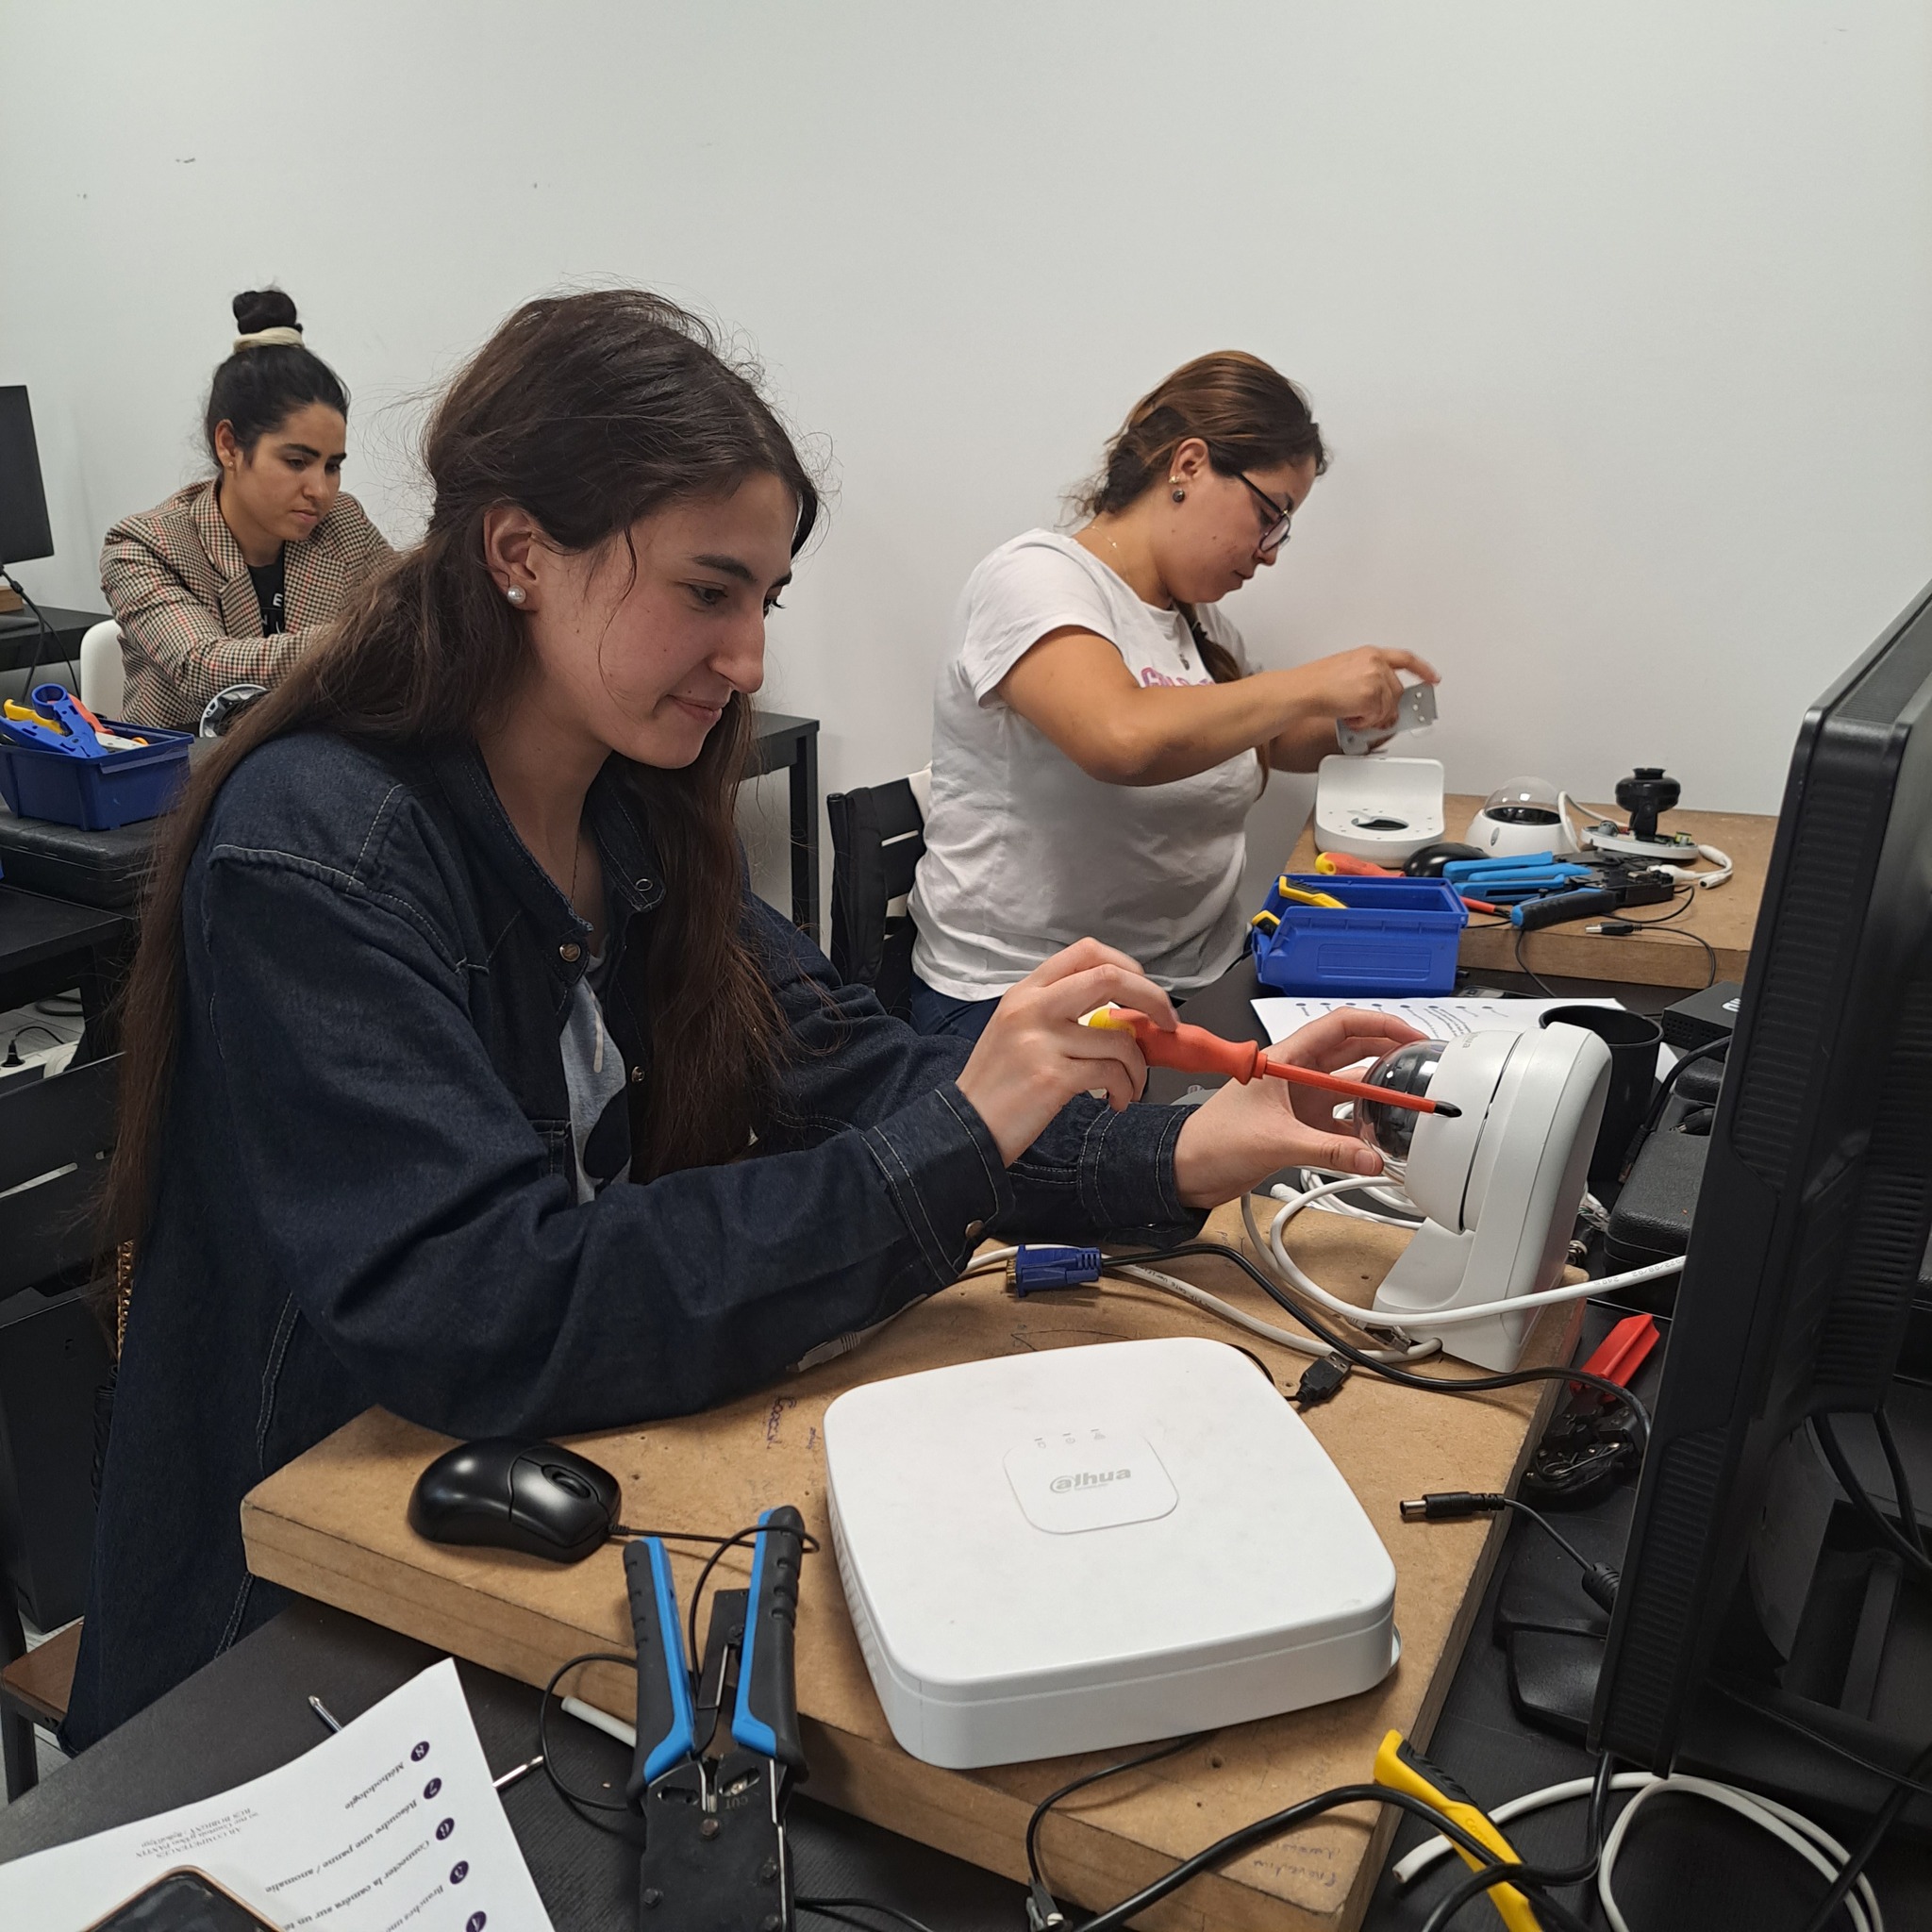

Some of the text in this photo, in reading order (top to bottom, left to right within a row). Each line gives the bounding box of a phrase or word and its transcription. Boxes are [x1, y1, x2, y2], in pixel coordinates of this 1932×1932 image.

[344, 1761, 405, 1810] Méthodologie
[375, 1798, 418, 1835] Résoudre
[355, 1833, 374, 1849] une
[322, 1843, 354, 1869] panne
[384, 1840, 430, 1880] Connecter
[265, 1868, 314, 1894] anomalie
[373, 1876, 383, 1887] la
[334, 1885, 372, 1909] caméra
[296, 1915, 313, 1925] un
[314, 1907, 333, 1920] sur
